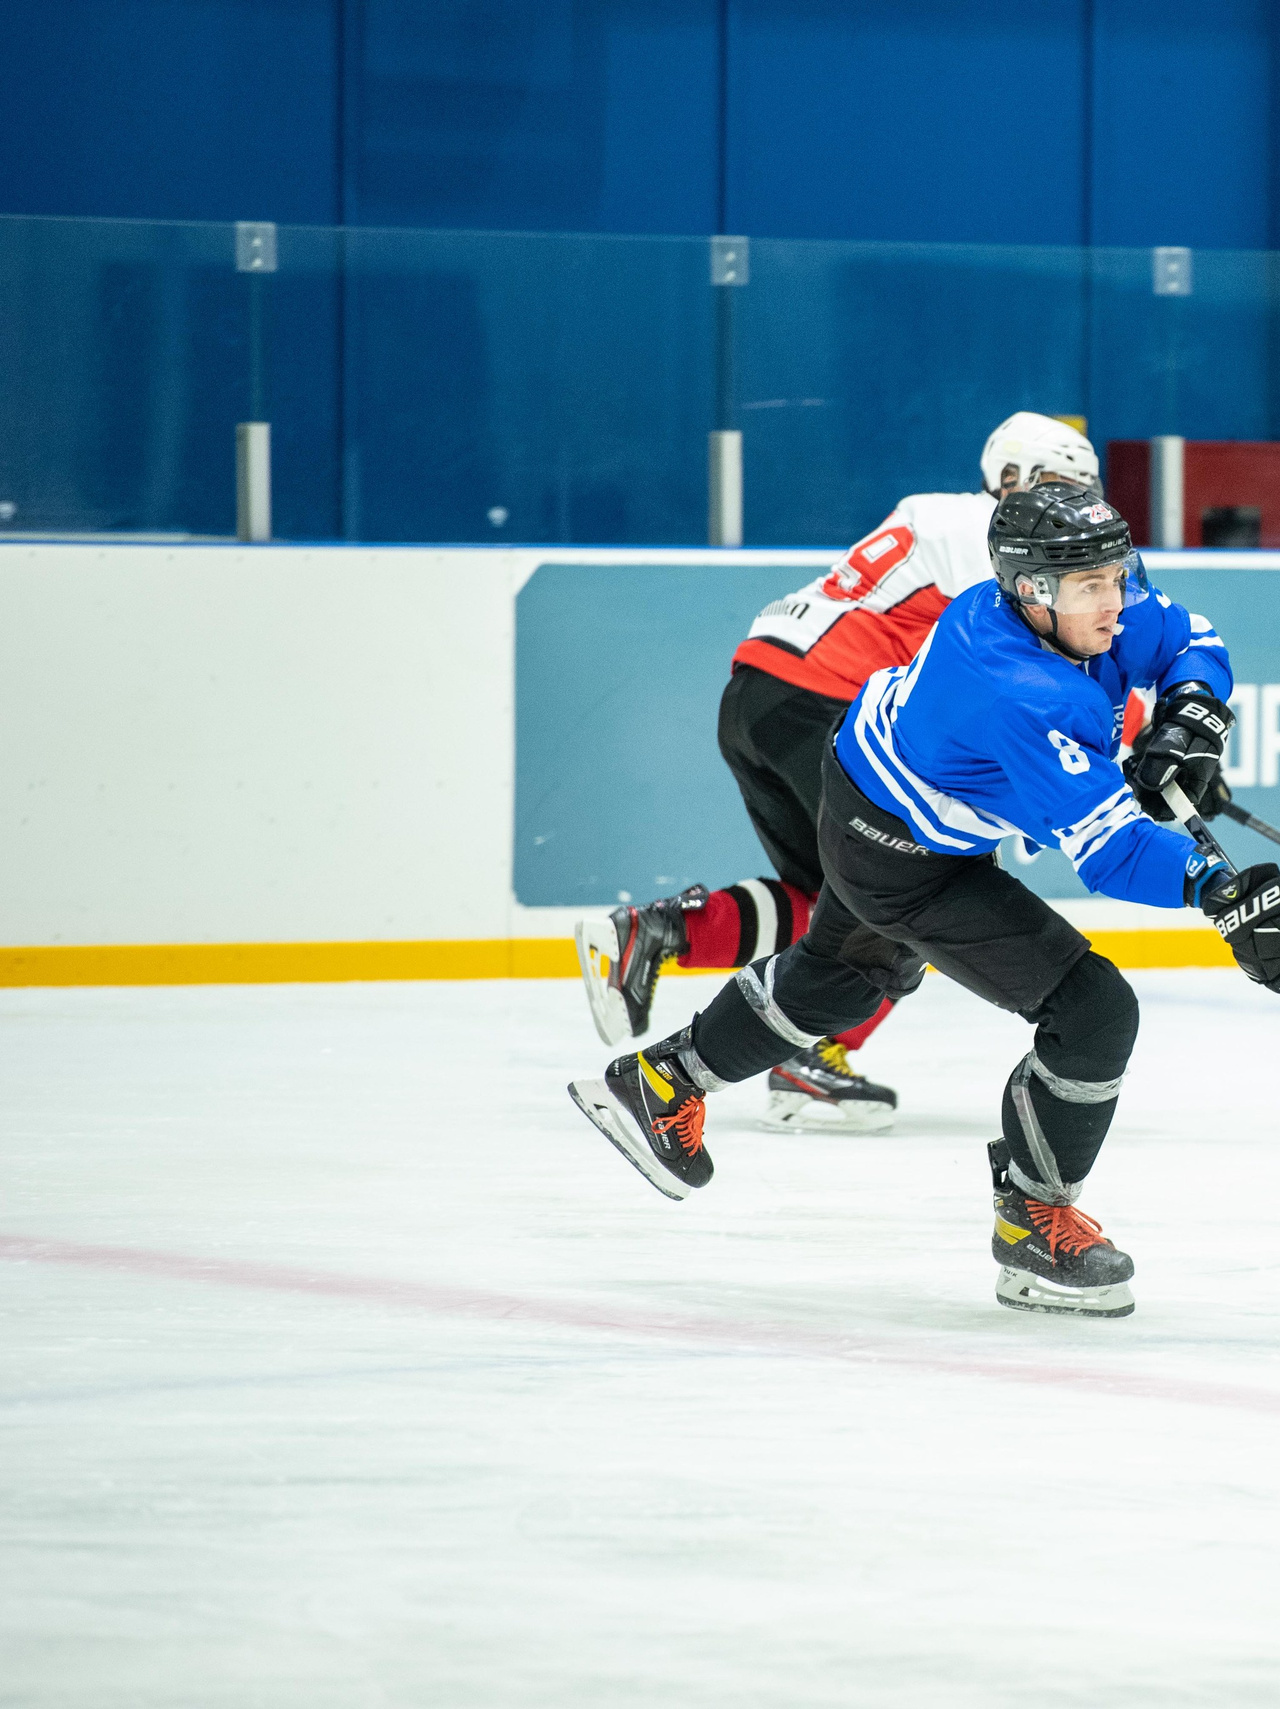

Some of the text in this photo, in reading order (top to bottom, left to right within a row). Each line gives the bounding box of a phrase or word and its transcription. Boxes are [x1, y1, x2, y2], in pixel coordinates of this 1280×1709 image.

[999, 545, 1029, 555] BAUER
[1047, 729, 1091, 775] 8
[848, 816, 929, 856] BAUER
